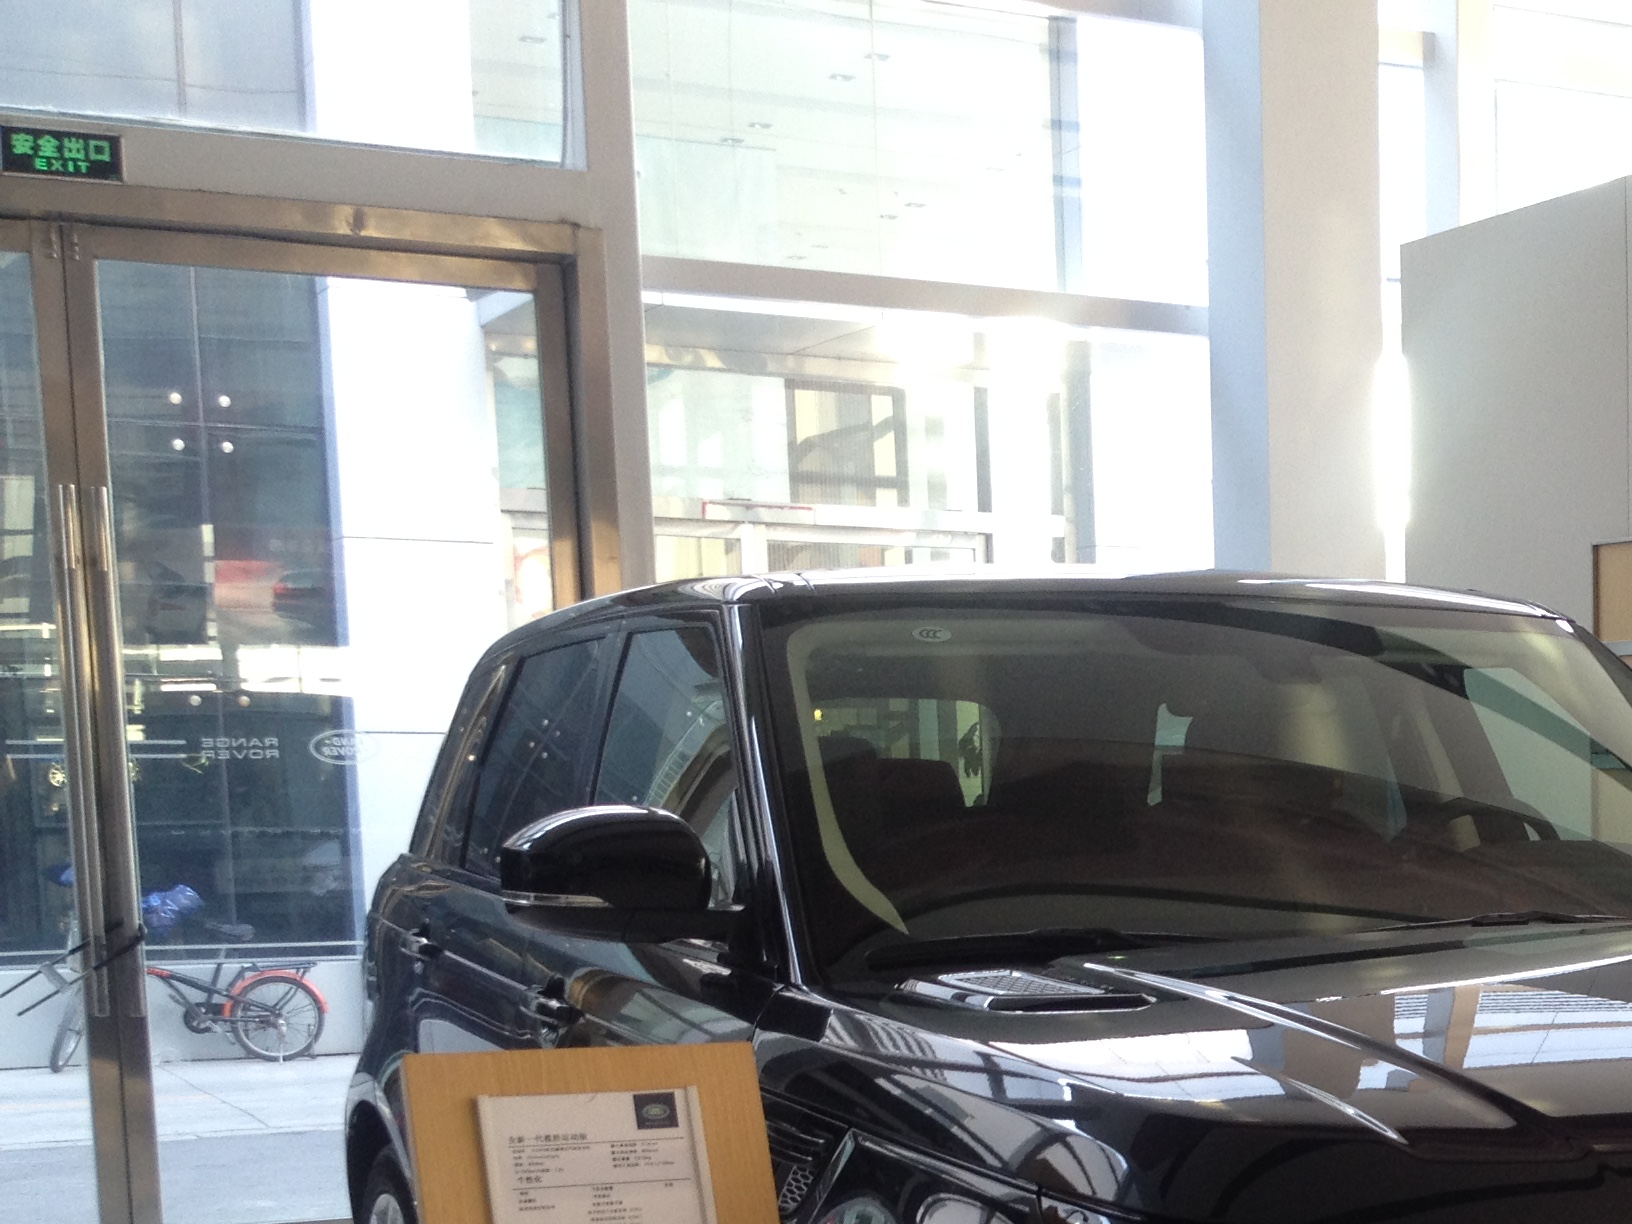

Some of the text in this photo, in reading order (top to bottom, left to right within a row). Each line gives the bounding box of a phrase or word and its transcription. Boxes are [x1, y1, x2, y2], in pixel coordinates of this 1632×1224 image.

[10, 132, 112, 162] 安全出口
[34, 157, 91, 174] EXIT
